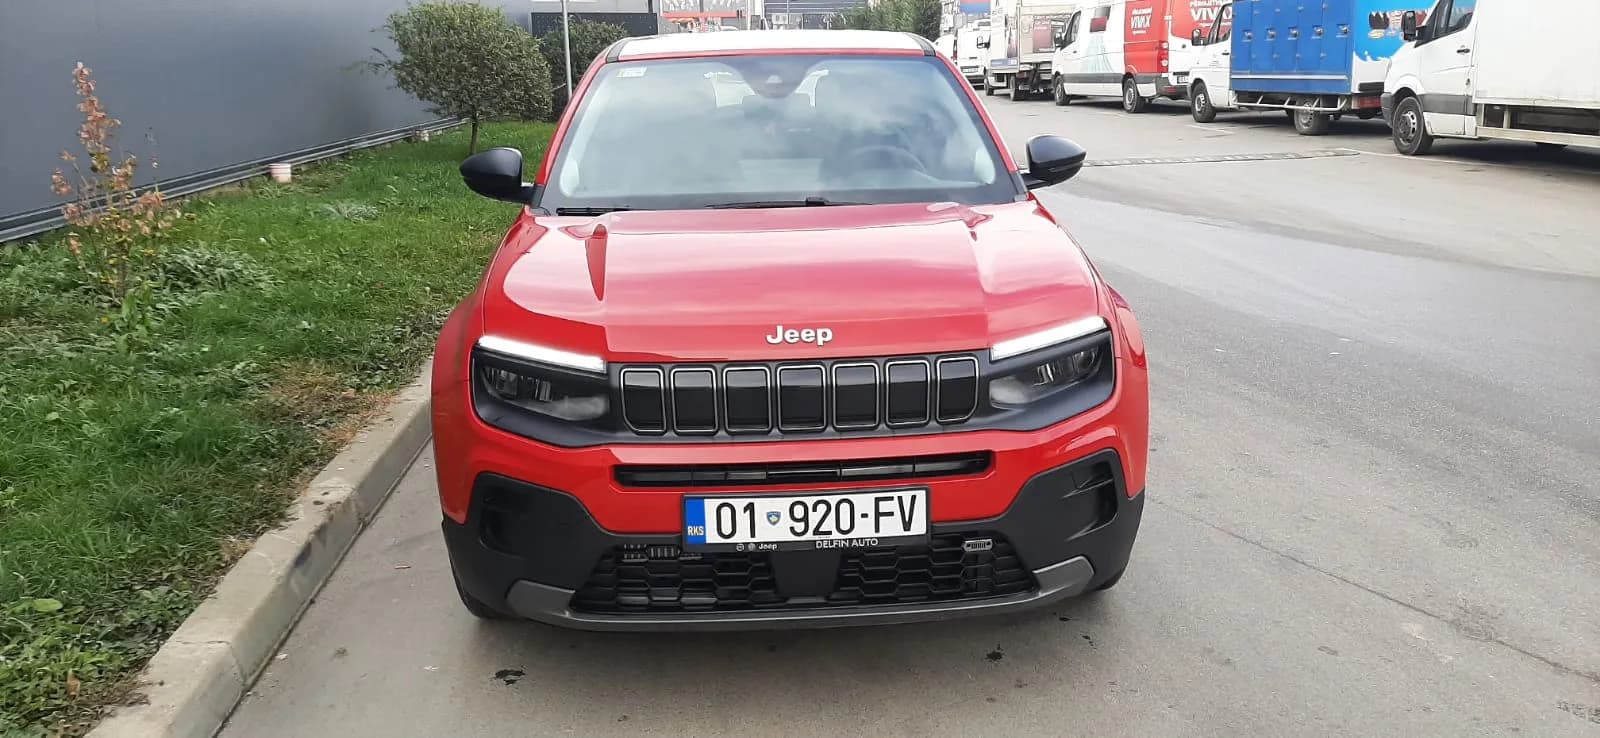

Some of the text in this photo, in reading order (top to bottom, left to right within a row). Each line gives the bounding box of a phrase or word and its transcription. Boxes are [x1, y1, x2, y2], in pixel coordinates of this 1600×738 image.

[766, 325, 833, 346] Jeep
[716, 495, 917, 539] 01 920-FV
[687, 526, 704, 536] RKS
[758, 543, 777, 551] Jeep
[815, 538, 878, 549] DELFIN AUTO
